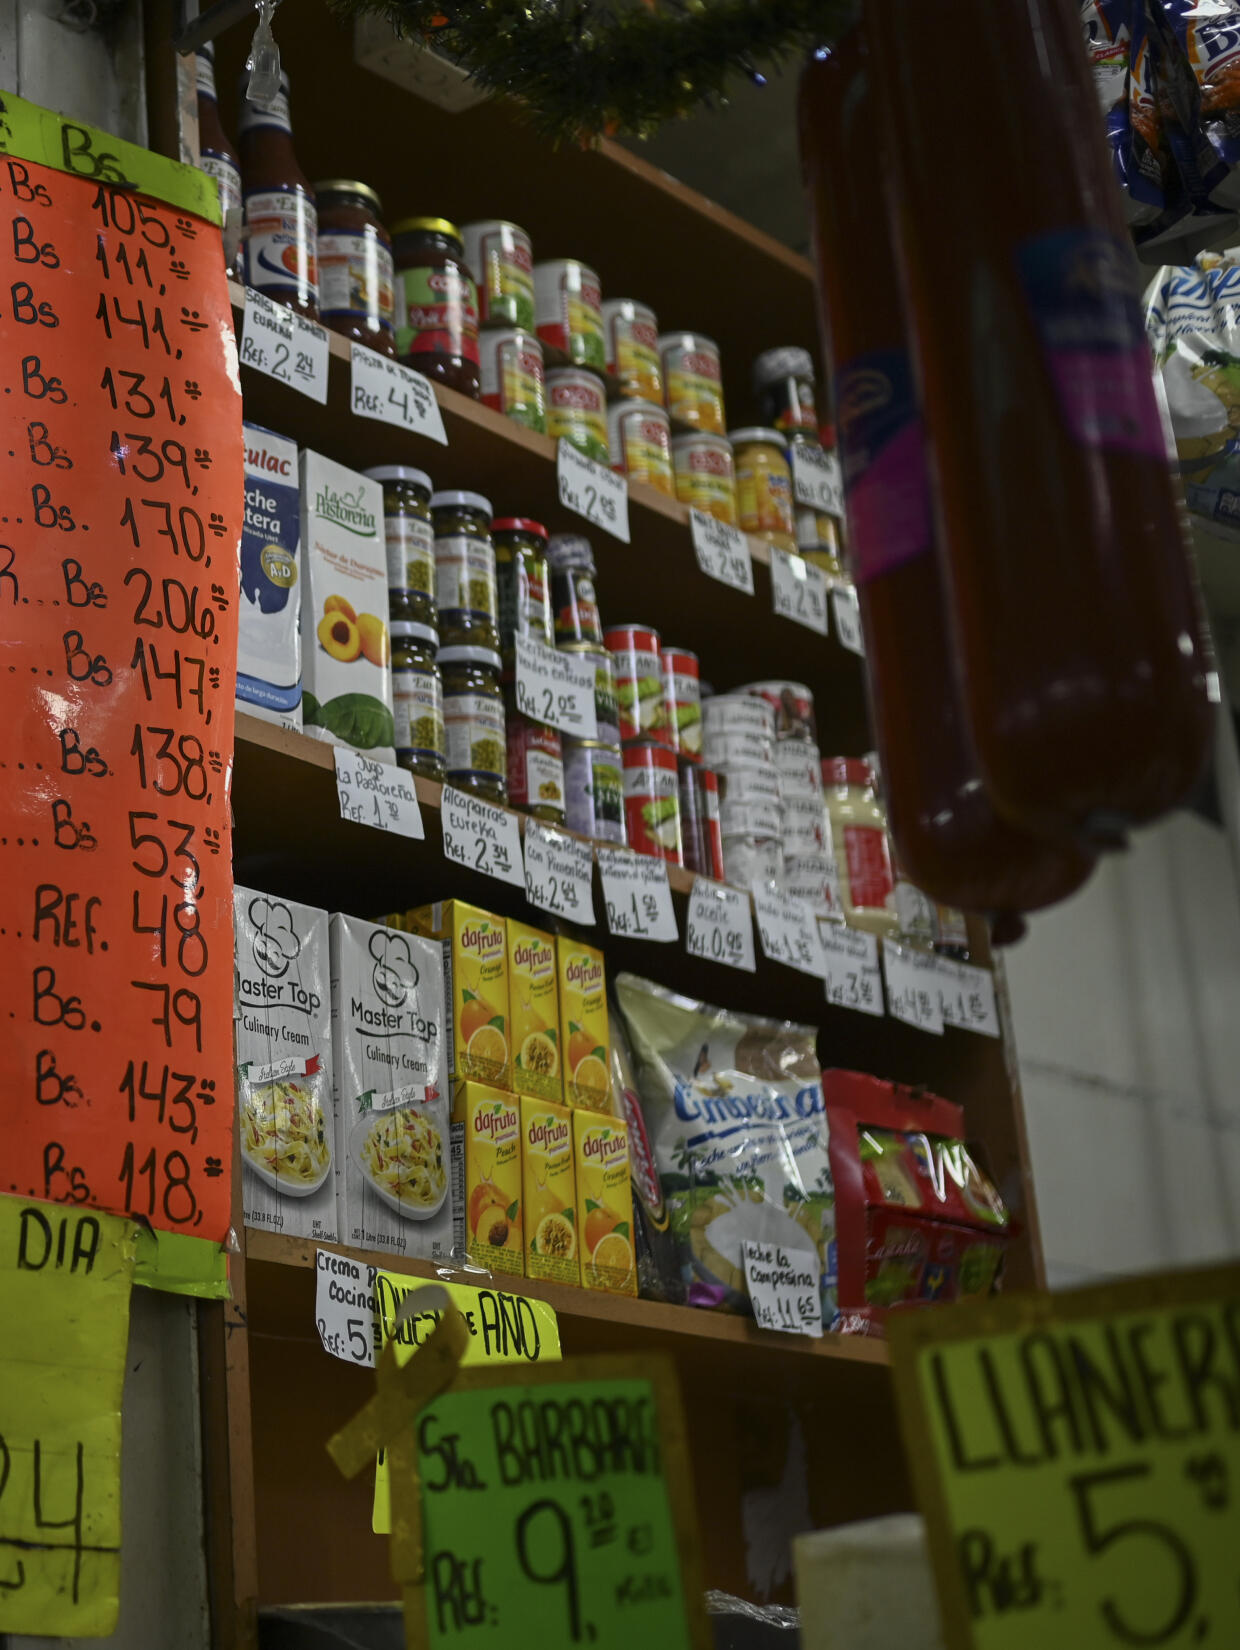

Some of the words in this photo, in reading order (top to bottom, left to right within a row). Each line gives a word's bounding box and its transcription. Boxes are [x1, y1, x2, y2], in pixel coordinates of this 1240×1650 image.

[315, 491, 377, 530] Pastoreña
[355, 751, 385, 782] Jugo
[336, 767, 352, 785] La
[355, 771, 415, 803] Pastoreña
[443, 787, 508, 828] Alcaparras
[131, 891, 210, 978] 48
[461, 926, 503, 956] dafruta
[514, 944, 553, 973] dafruta
[566, 961, 602, 989] dafruta
[287, 981, 321, 1014] Top
[131, 979, 204, 1053] 79
[243, 1014, 280, 1042] Culinary
[281, 1024, 310, 1046] Cream
[351, 996, 403, 1030] Master
[407, 1010, 438, 1043] Top
[365, 1044, 400, 1068] Culinary
[401, 1055, 428, 1073] Cream
[474, 1109, 517, 1139] dafruta
[528, 1122, 569, 1151] dafruta
[583, 1135, 626, 1163] dafruta
[18, 1207, 101, 1274] DIA
[316, 1251, 360, 1281] Crema
[478, 1290, 541, 1362] AÑO
